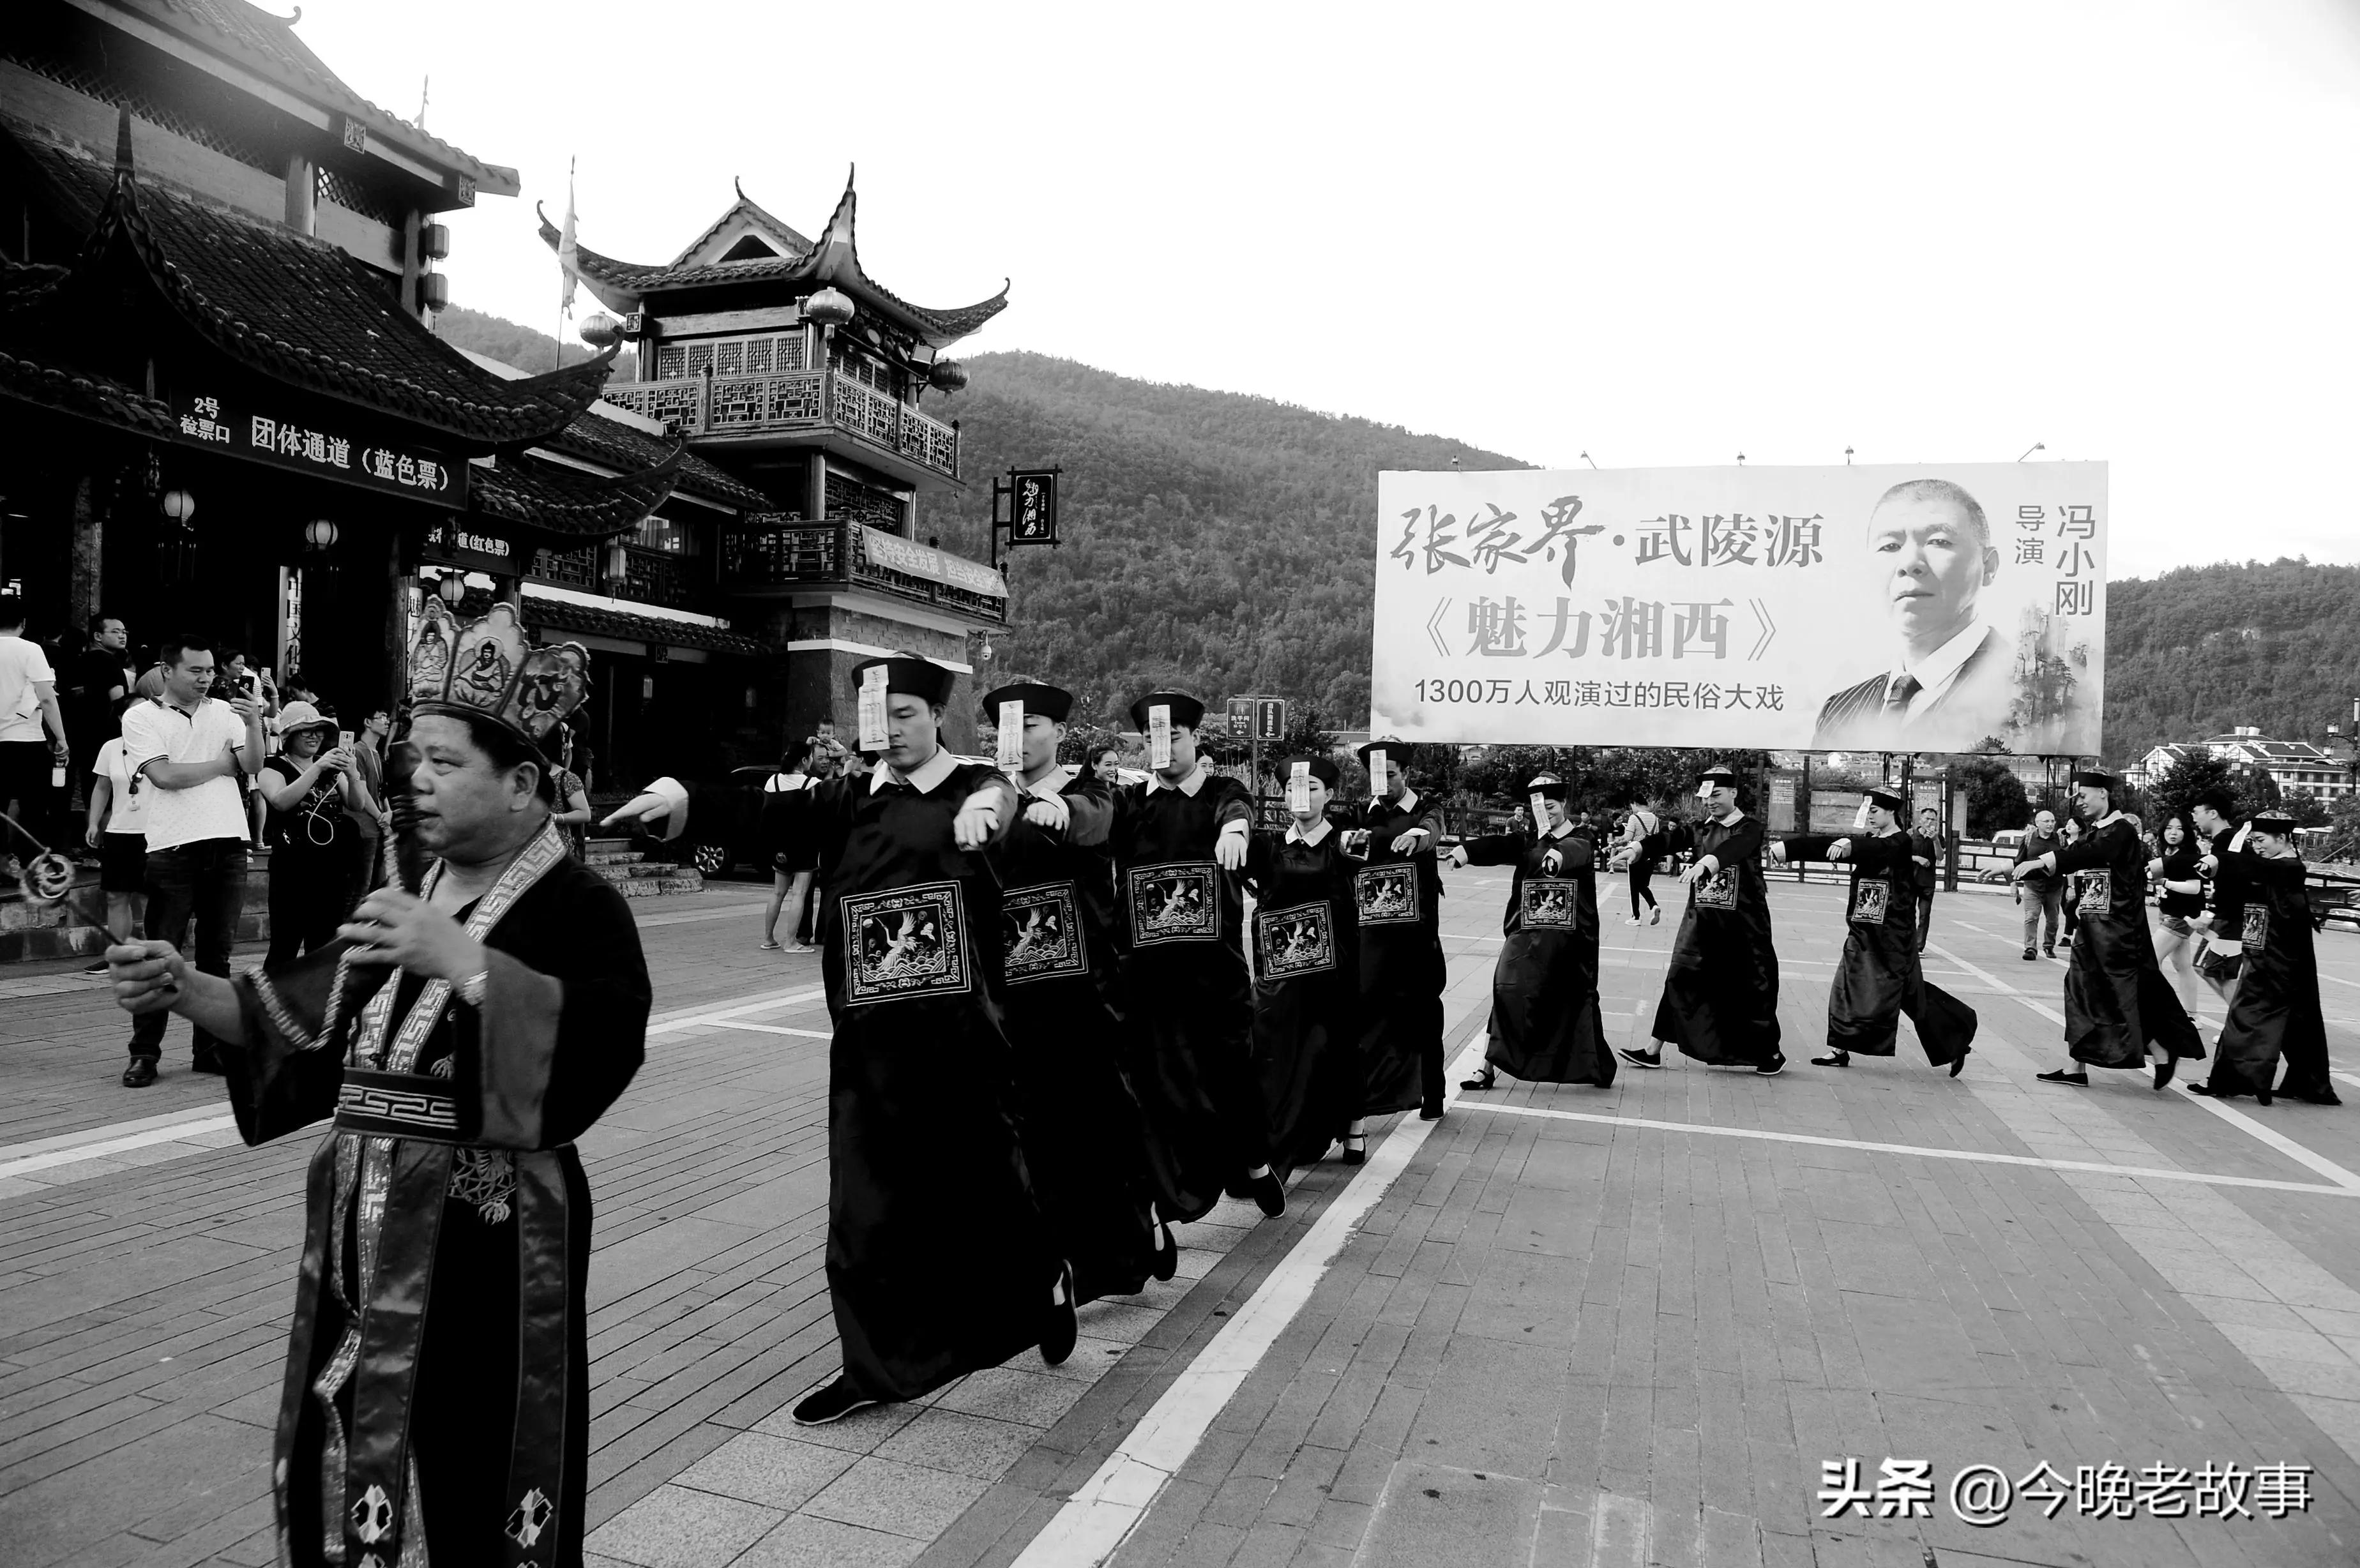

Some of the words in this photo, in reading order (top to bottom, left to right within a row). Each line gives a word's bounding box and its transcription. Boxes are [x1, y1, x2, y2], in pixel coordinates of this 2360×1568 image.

[195, 397, 220, 419] 2号
[252, 416, 448, 490] 团体通道（蓝色票）
[1022, 479, 1039, 536] 魅力湘西
[2015, 505, 2045, 564] 导演
[2056, 505, 2096, 615] 冯小刚
[1427, 596, 1776, 661] 《魅力湘西》
[1414, 679, 1785, 711] 1300万人观演过的民俗大戏
